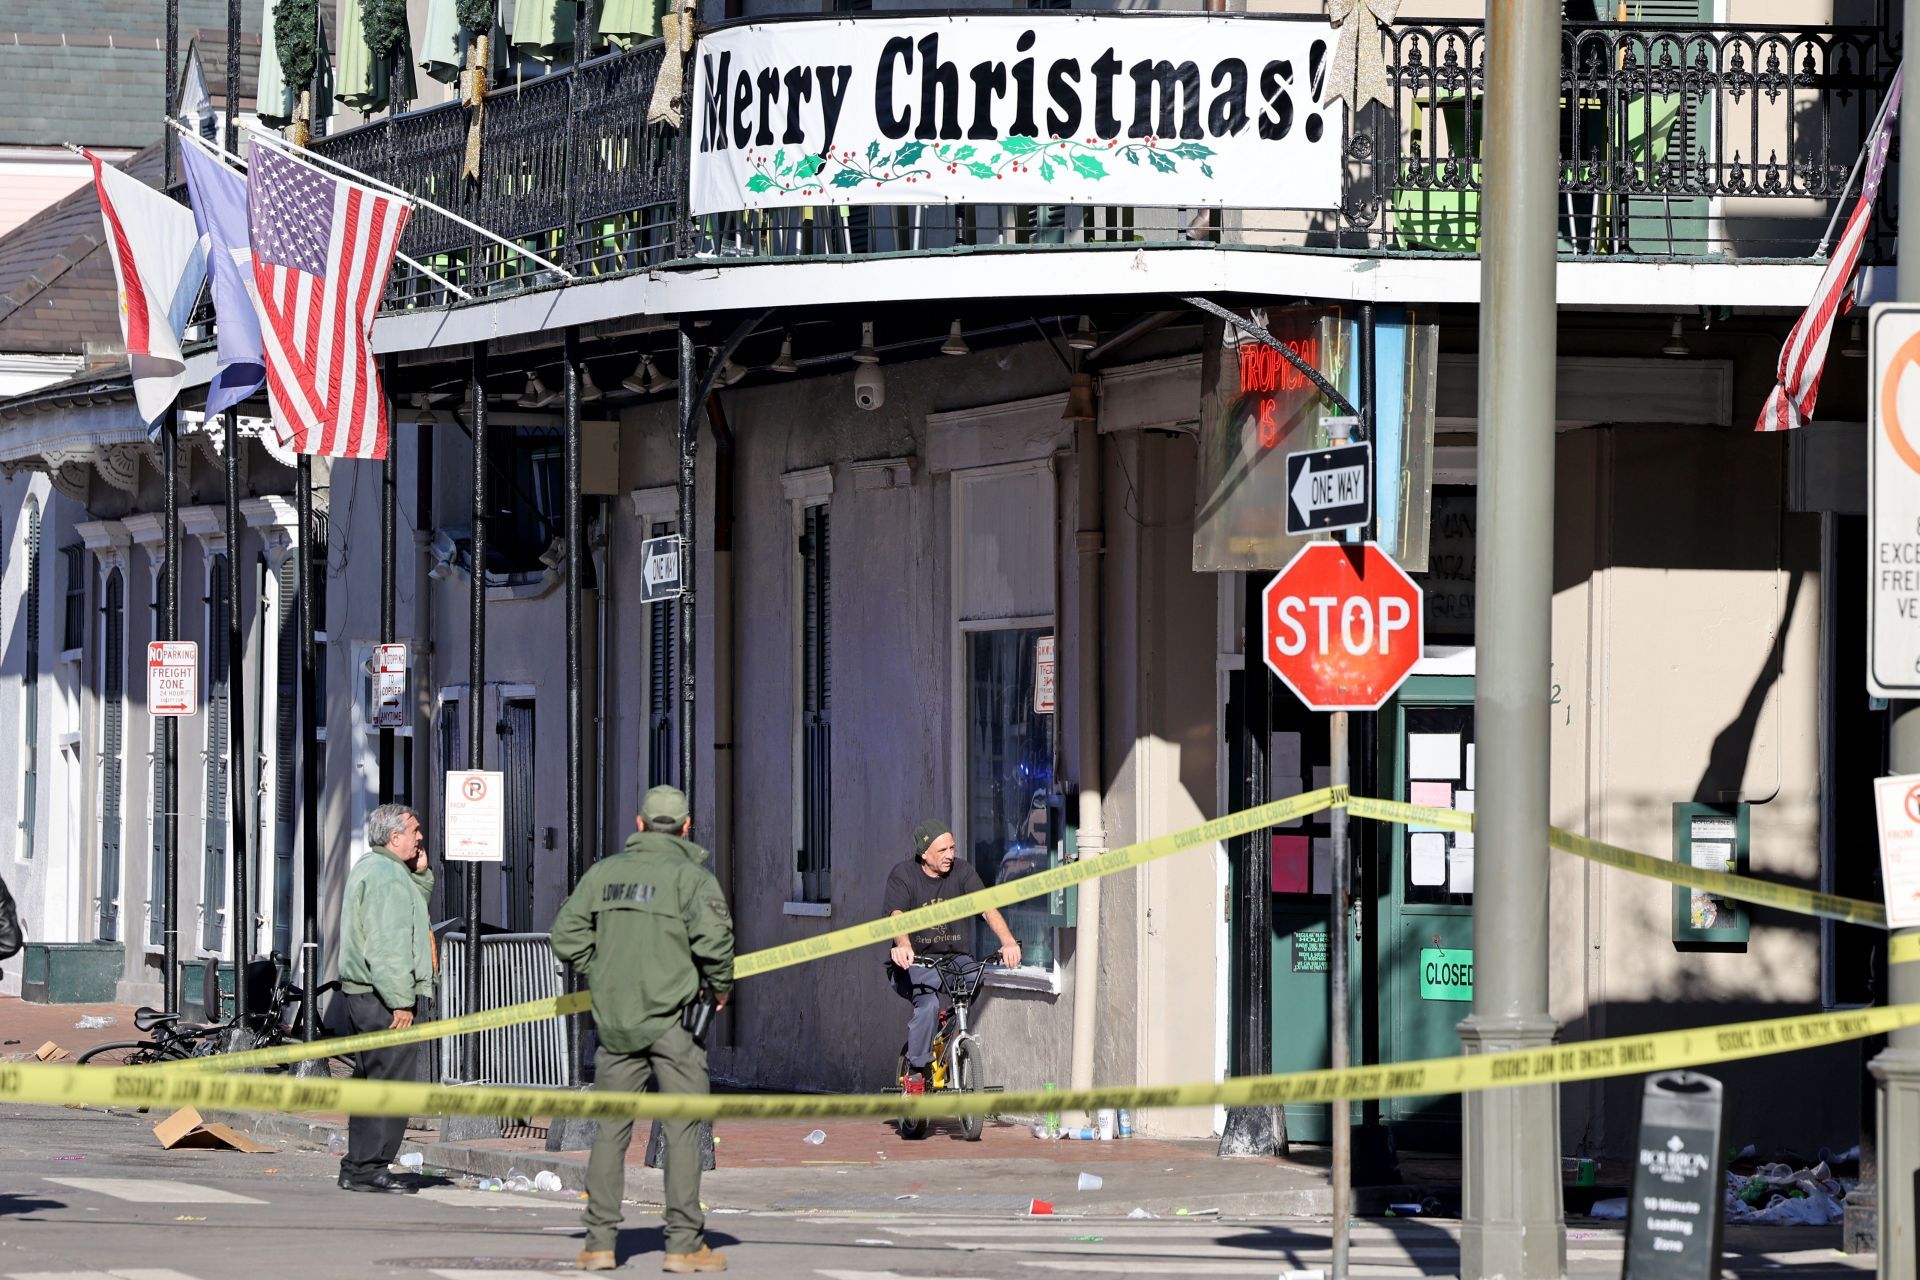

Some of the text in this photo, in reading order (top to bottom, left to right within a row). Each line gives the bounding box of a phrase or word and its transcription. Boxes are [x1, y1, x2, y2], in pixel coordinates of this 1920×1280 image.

[700, 30, 1329, 175] Merry Christmas!
[1311, 470, 1362, 506] ONE WAY
[653, 553, 677, 581] ONE WAY
[1275, 595, 1410, 657] STOP
[150, 647, 195, 662] NO PARKING
[153, 668, 191, 677] FREIGHT
[388, 674, 394, 683] TO
[160, 680, 185, 689] ZONE
[382, 687, 401, 696] CORNER
[382, 711, 402, 723] ANYTIME
